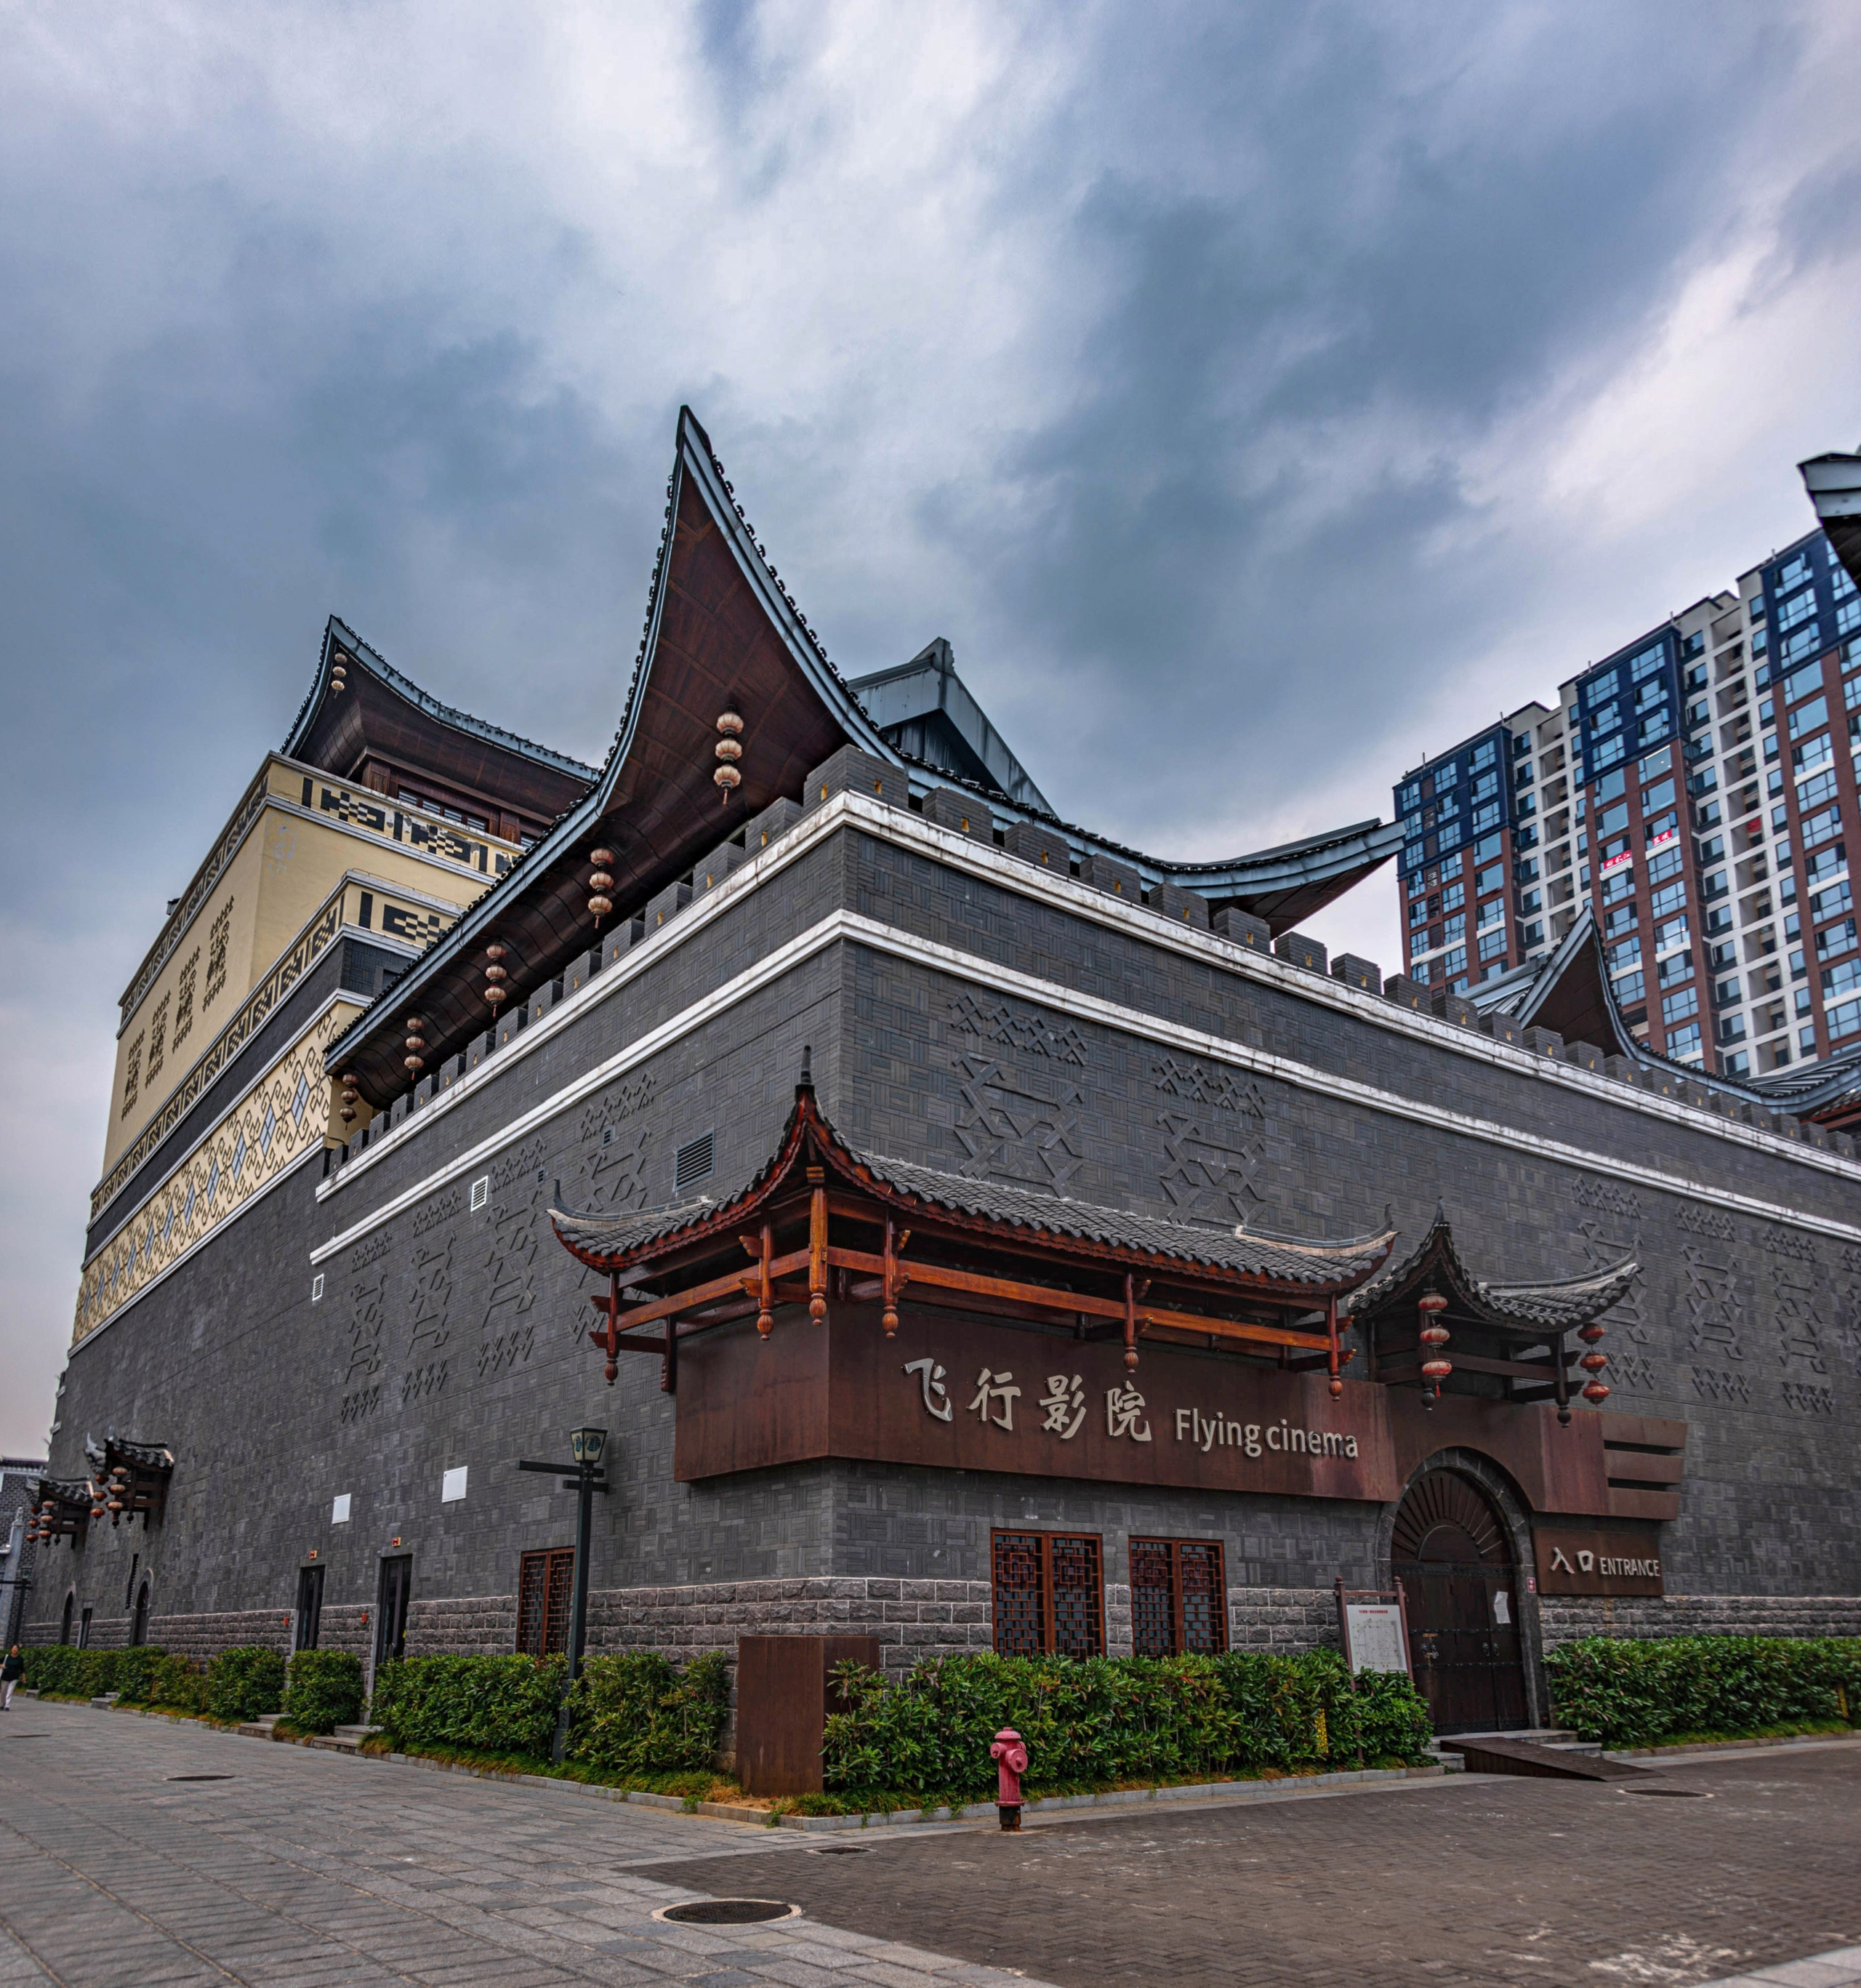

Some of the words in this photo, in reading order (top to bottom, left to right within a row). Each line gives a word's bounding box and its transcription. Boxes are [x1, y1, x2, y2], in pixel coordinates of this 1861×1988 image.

[904, 1358, 1152, 1441] 飞行影院
[1175, 1408, 1262, 1458] Flying
[1265, 1419, 1359, 1458] cinema
[1551, 1547, 1594, 1574] 入口
[1600, 1557, 1660, 1576] ENTRANCE
